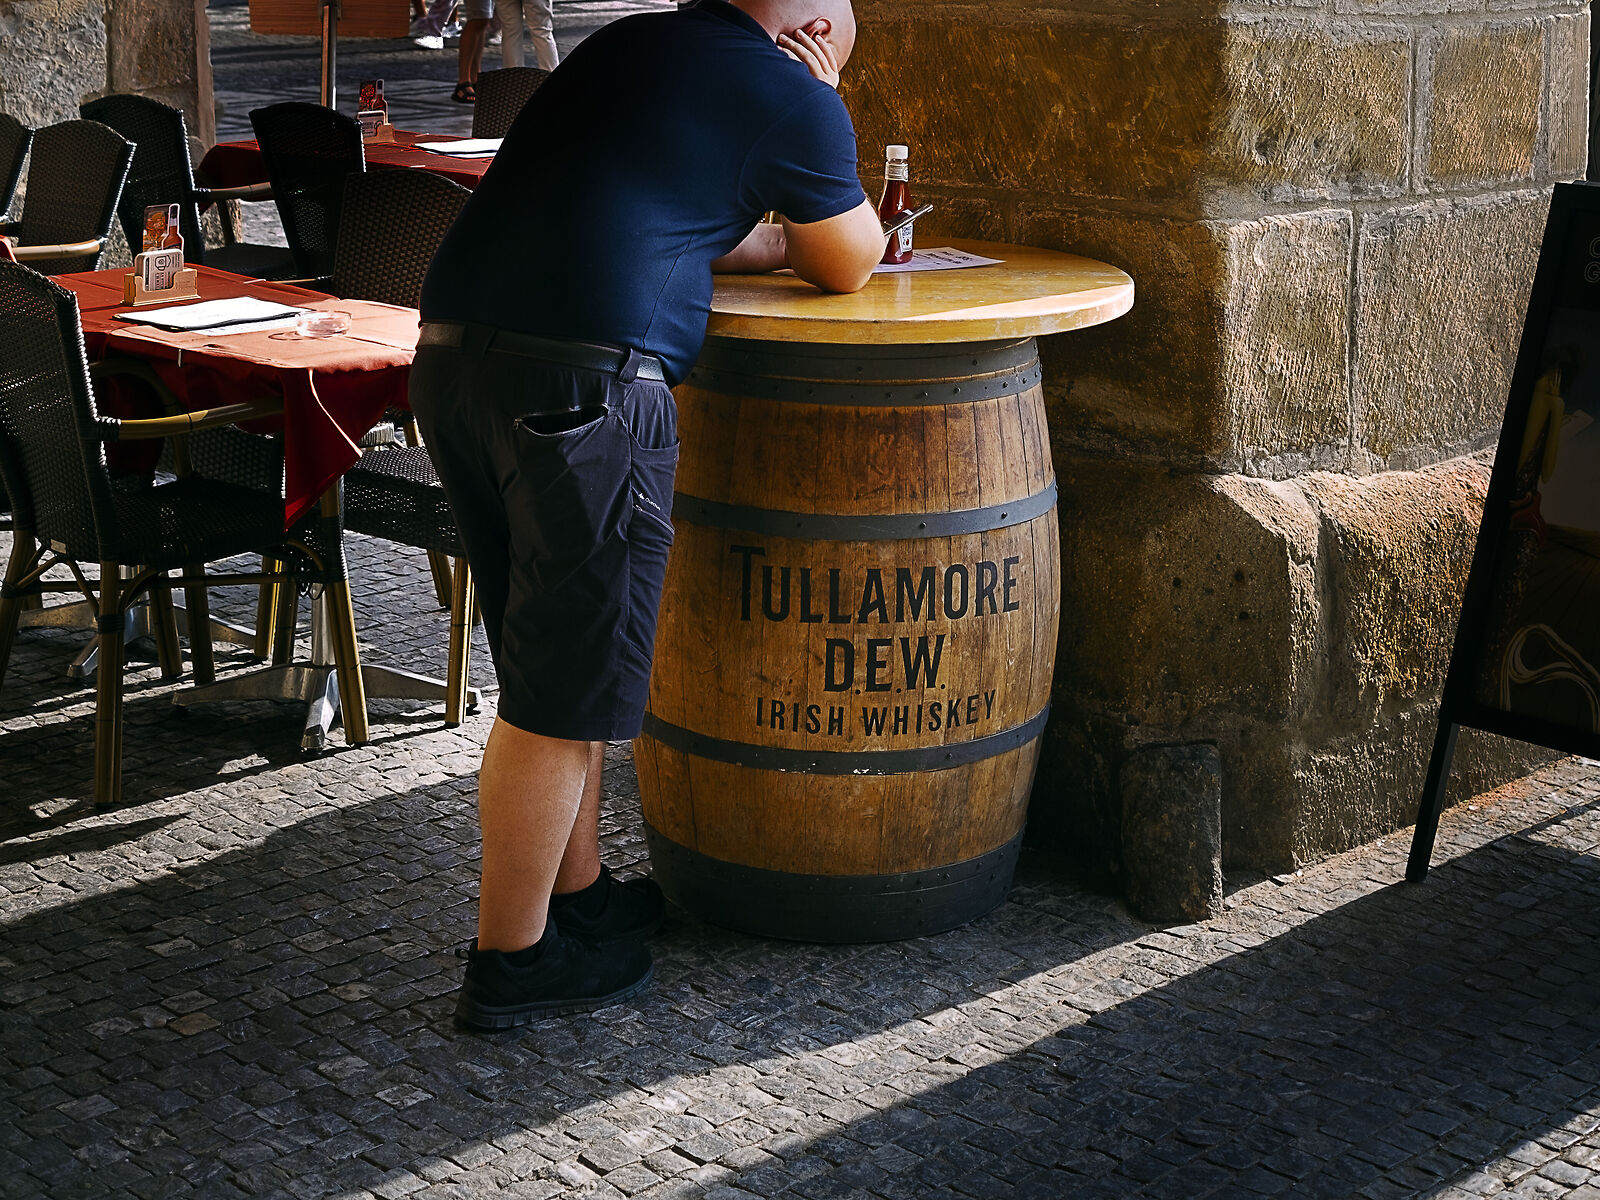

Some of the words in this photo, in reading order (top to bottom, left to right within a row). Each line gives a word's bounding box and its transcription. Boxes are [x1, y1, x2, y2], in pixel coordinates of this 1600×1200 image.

[729, 544, 1021, 624] TULLAMORE
[823, 634, 947, 696] D.E.W.
[755, 697, 845, 736] IRISH
[861, 690, 997, 737] WHISKEY
